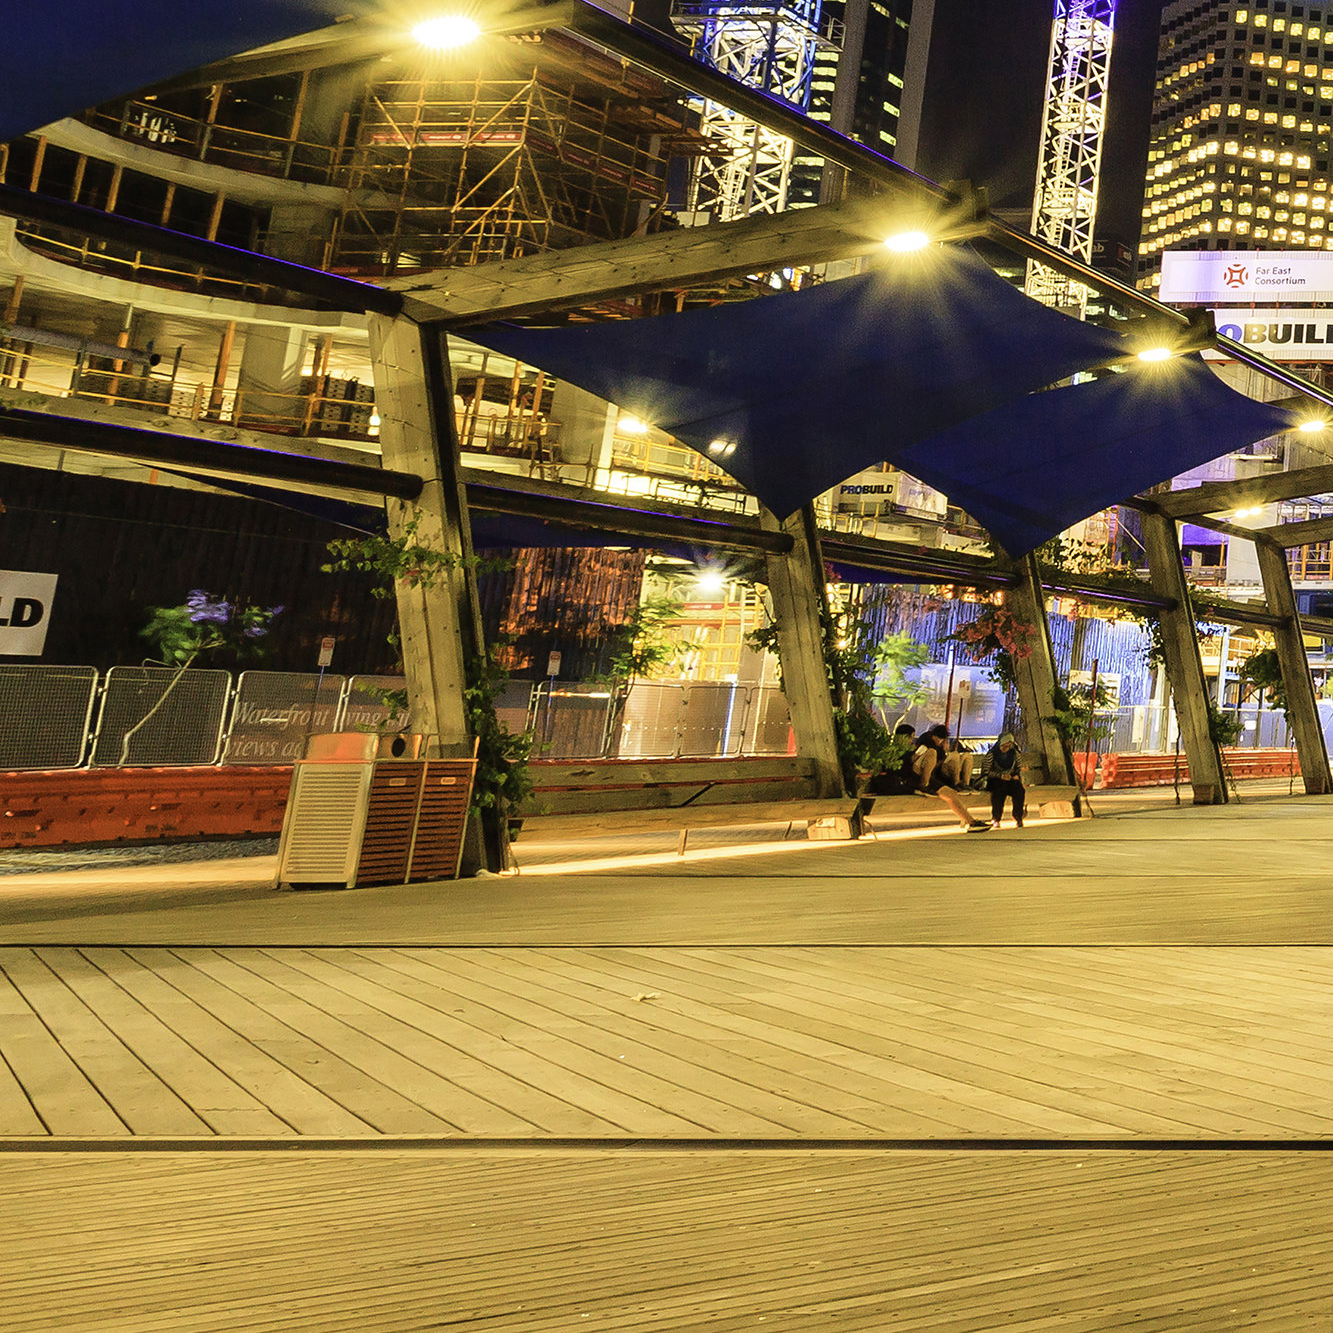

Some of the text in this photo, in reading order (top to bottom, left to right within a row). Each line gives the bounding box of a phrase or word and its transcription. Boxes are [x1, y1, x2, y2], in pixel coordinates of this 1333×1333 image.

[1255, 266, 1291, 275] Far East
[1255, 276, 1306, 286] Consortium
[840, 484, 894, 495] PROBUILD
[235, 702, 329, 732] Waterfront
